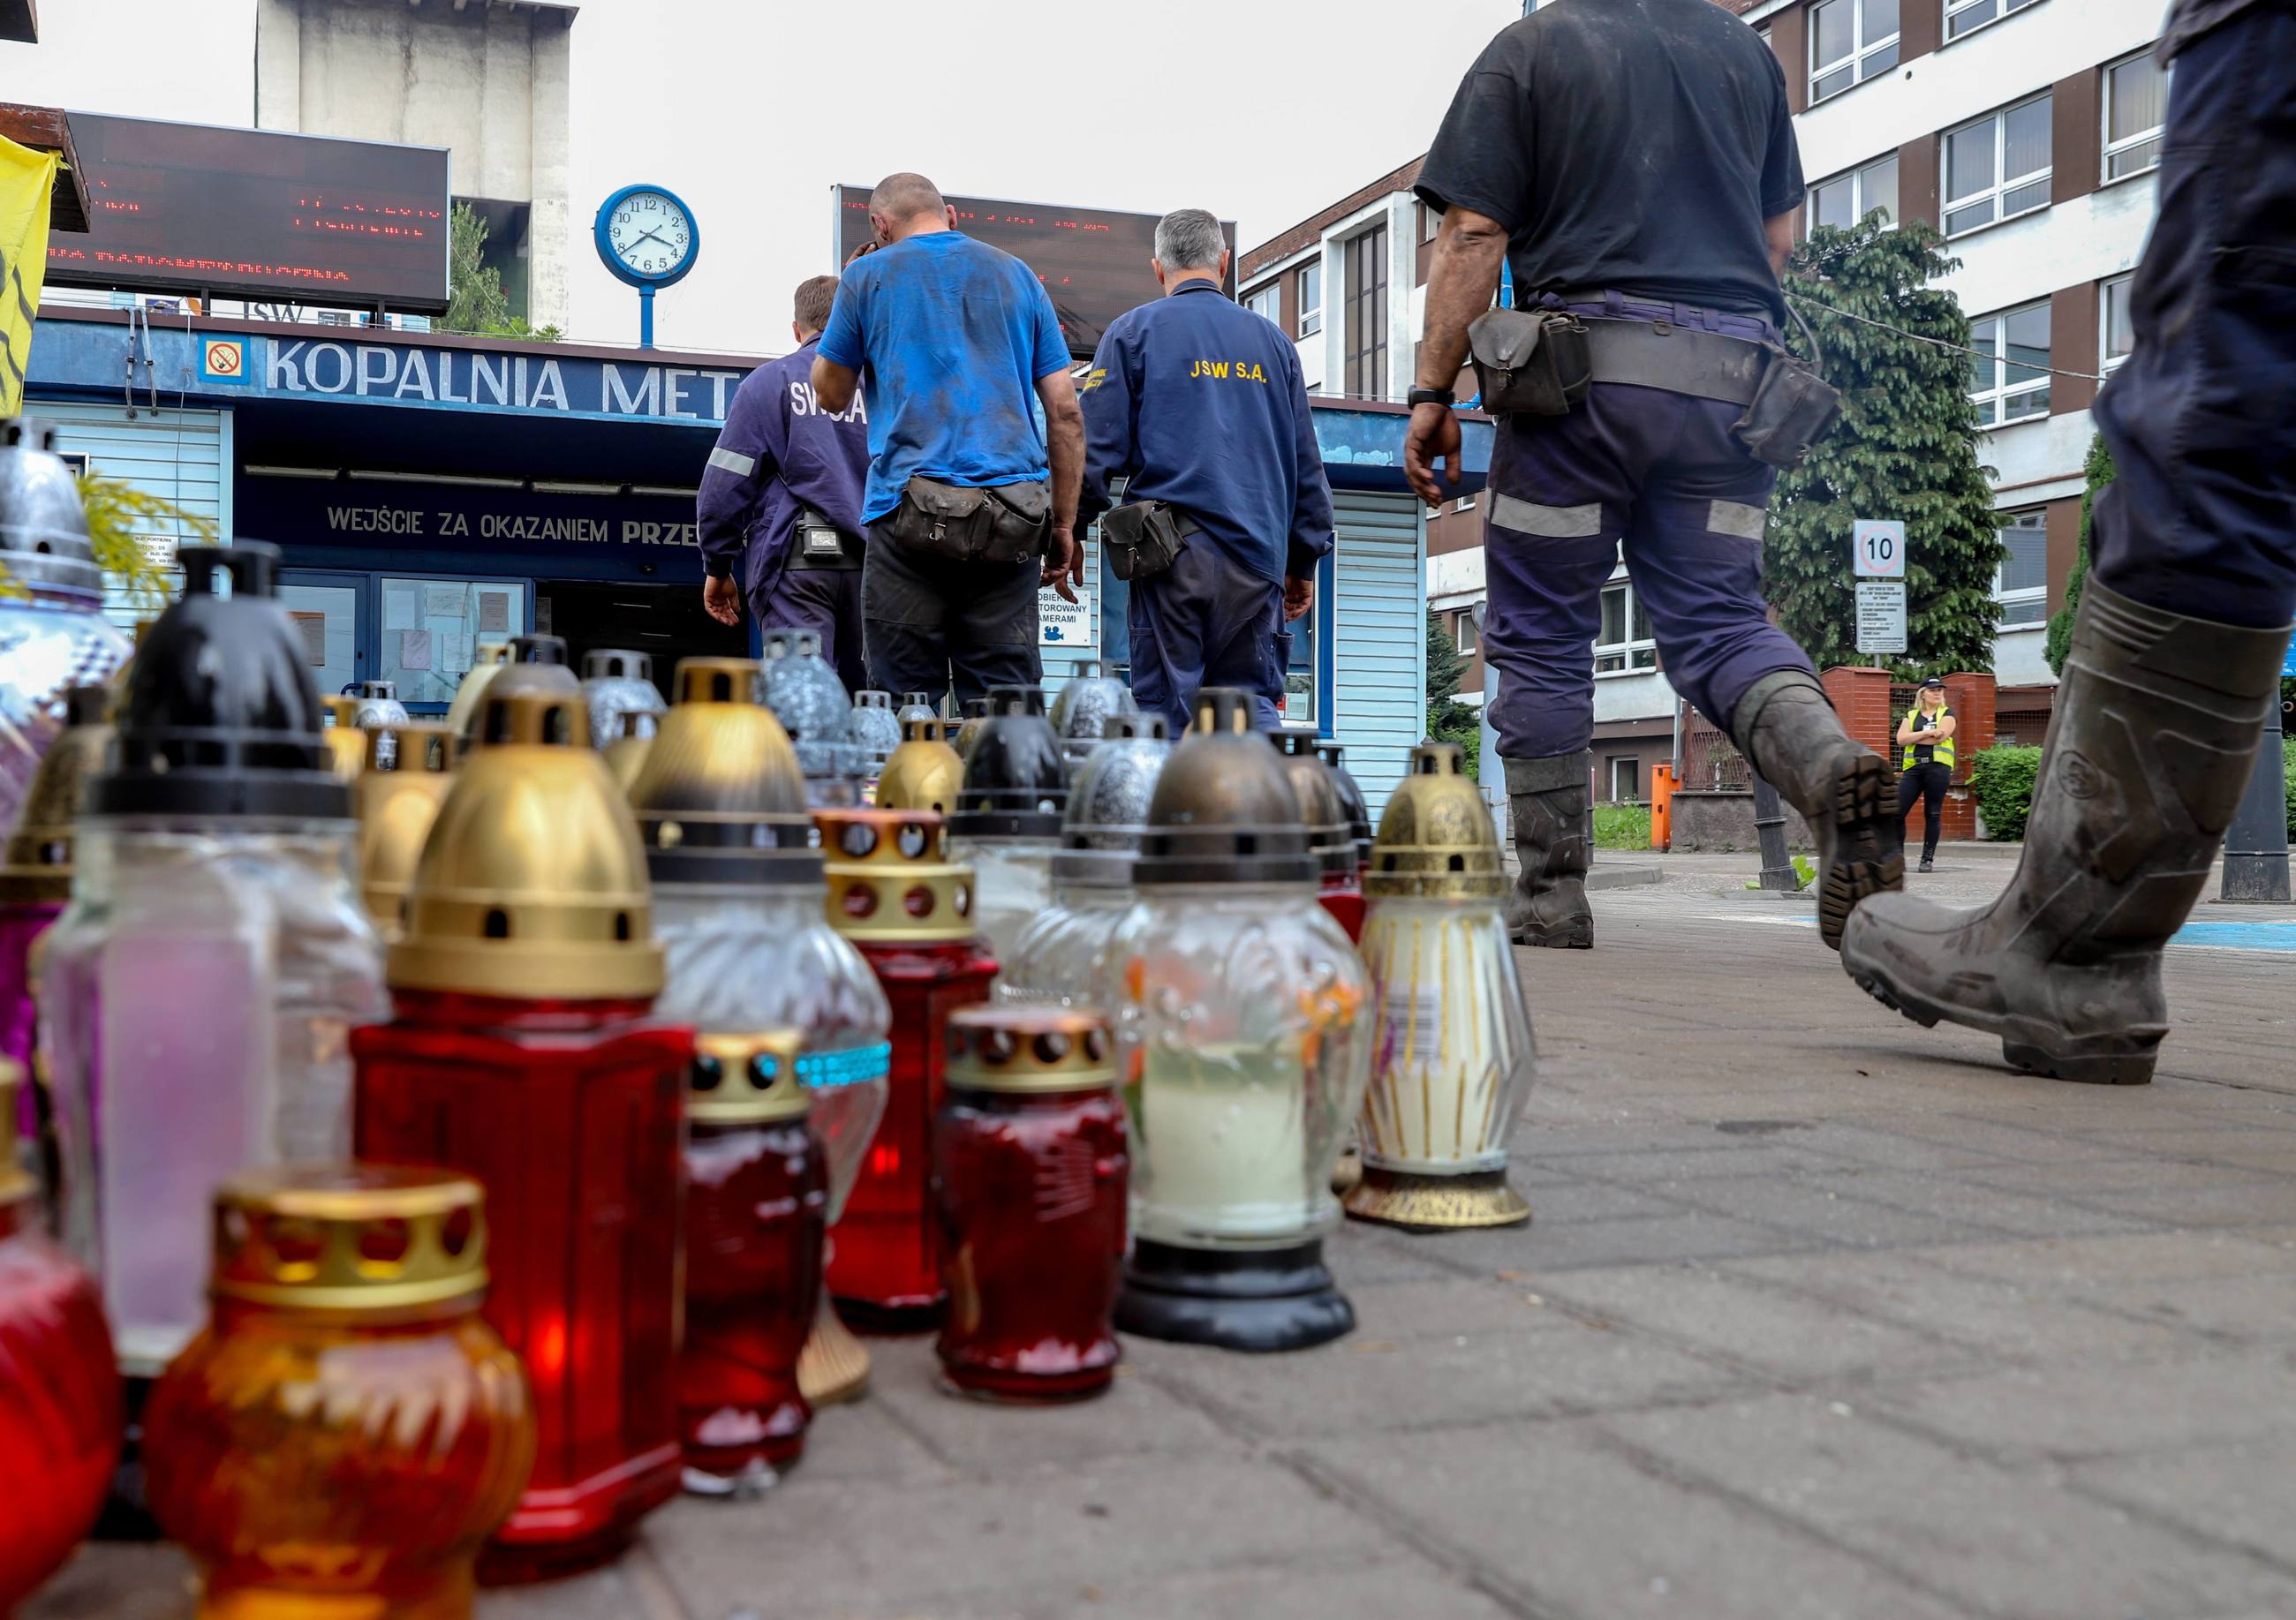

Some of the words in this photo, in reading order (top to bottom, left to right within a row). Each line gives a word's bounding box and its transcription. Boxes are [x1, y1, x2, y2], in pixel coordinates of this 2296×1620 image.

[631, 201, 639, 212] 11
[644, 199, 657, 210] 12
[661, 204, 667, 215] 1
[618, 213, 631, 223] 10
[671, 216, 679, 227] 2
[612, 227, 621, 237] 9
[676, 233, 684, 244] 3
[617, 242, 626, 254] 8
[670, 248, 678, 258] 4
[630, 254, 638, 266] 7
[644, 260, 652, 270] 6
[659, 257, 667, 268] 5
[267, 339, 570, 411] KOPALNIA
[1190, 360, 1229, 378] JSW
[1236, 362, 1267, 383] S.A.
[327, 505, 424, 534] WEJŚCIE
[438, 512, 469, 537] ZA
[480, 514, 608, 542] OKAZANIEM
[1867, 538, 1892, 560] 10
